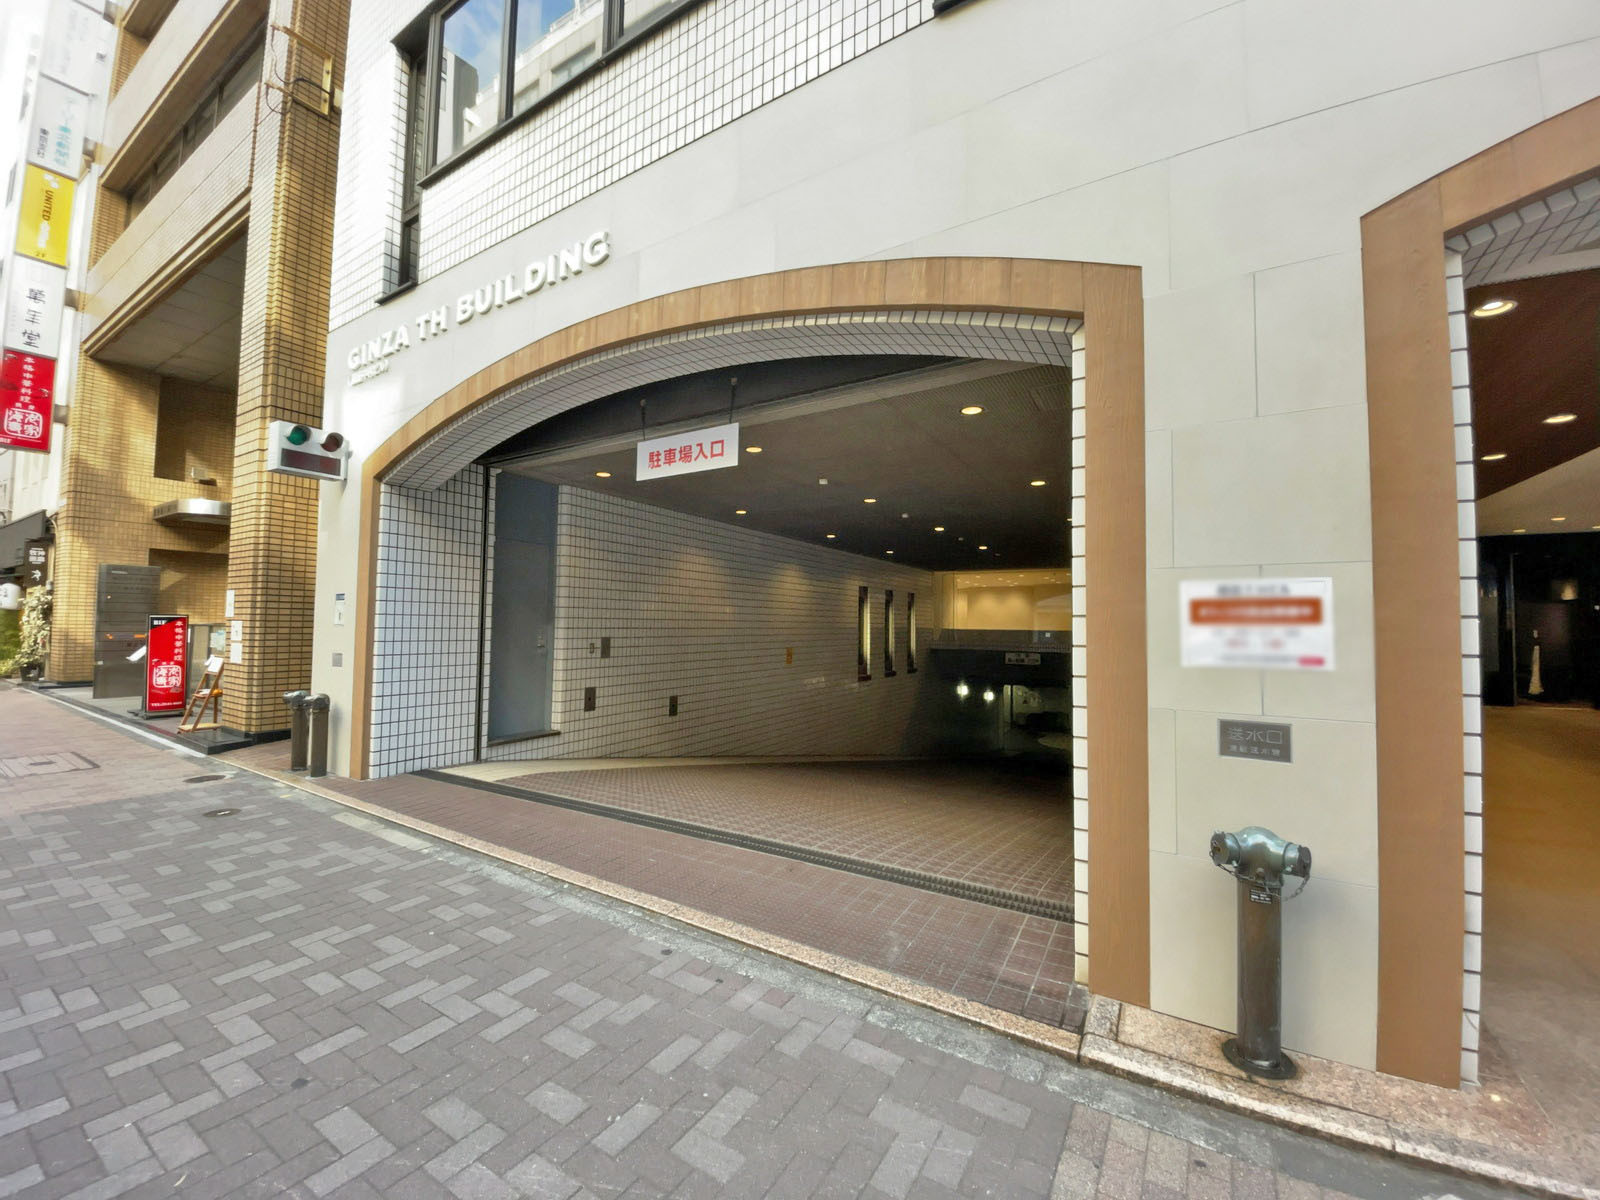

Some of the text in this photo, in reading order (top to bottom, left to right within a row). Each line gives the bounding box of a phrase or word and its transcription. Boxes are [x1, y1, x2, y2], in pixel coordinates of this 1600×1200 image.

[42, 189, 54, 221] UNITED
[347, 231, 610, 372] GINZA TH BUILDING
[648, 439, 724, 469] 駐車場入口
[1228, 727, 1283, 745] 送水口
